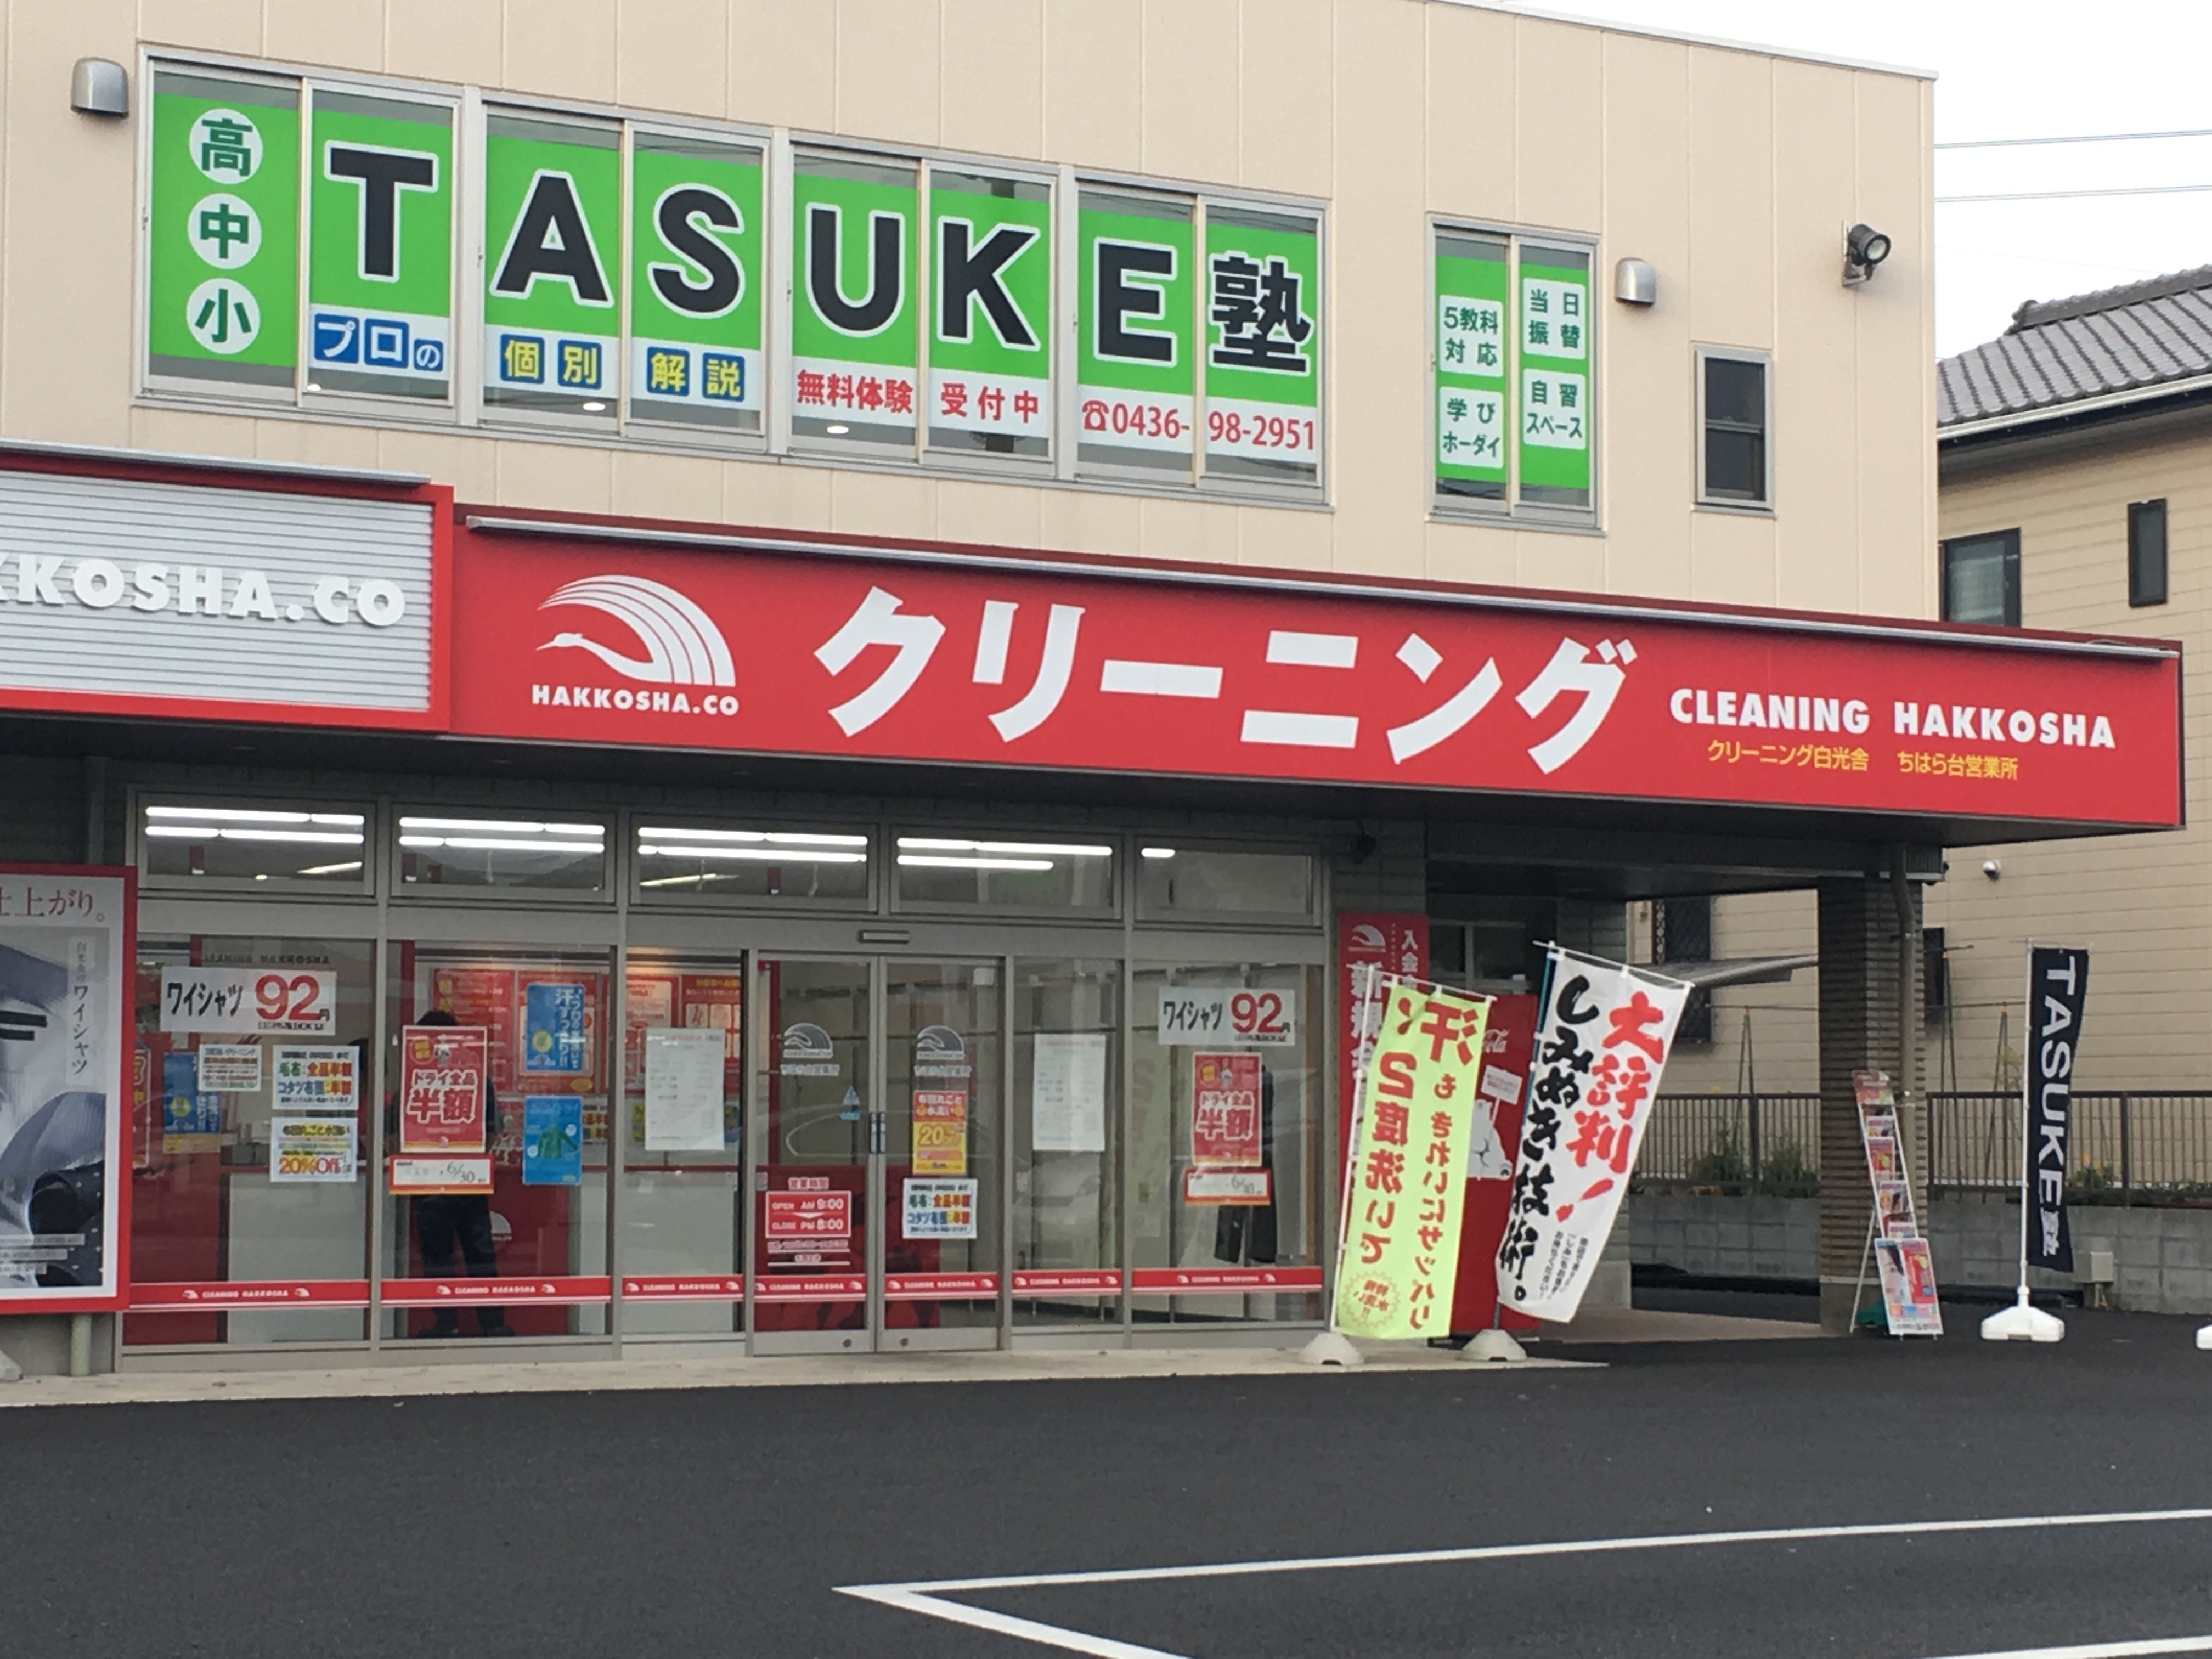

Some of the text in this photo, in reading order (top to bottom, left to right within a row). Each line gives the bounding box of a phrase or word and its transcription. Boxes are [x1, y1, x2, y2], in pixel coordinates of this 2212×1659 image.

[1530, 289, 1579, 317] 当日
[1443, 307, 1499, 335] 5教科
[1528, 320, 1581, 349] 振替
[317, 319, 441, 369] プロの
[1444, 337, 1498, 366] 対応
[797, 369, 913, 415] 無料体験
[940, 382, 1039, 425] 受付中
[1531, 380, 1577, 408] 自習
[1447, 398, 1495, 424] 学び
[1526, 412, 1583, 439] スペース
[1442, 432, 1500, 458] ホーダイ
[0, 552, 406, 627] KOSHA.CO
[814, 585, 1637, 774] クリーニング
[532, 685, 740, 716] HAKKOSHA.CO
[1669, 687, 2116, 748] CLEANING HAKKOSHA
[1897, 751, 2018, 780] ちはら台営業所
[167, 982, 244, 1017] ワイシャツ
[1163, 1000, 1223, 1031] ワイシャツ
